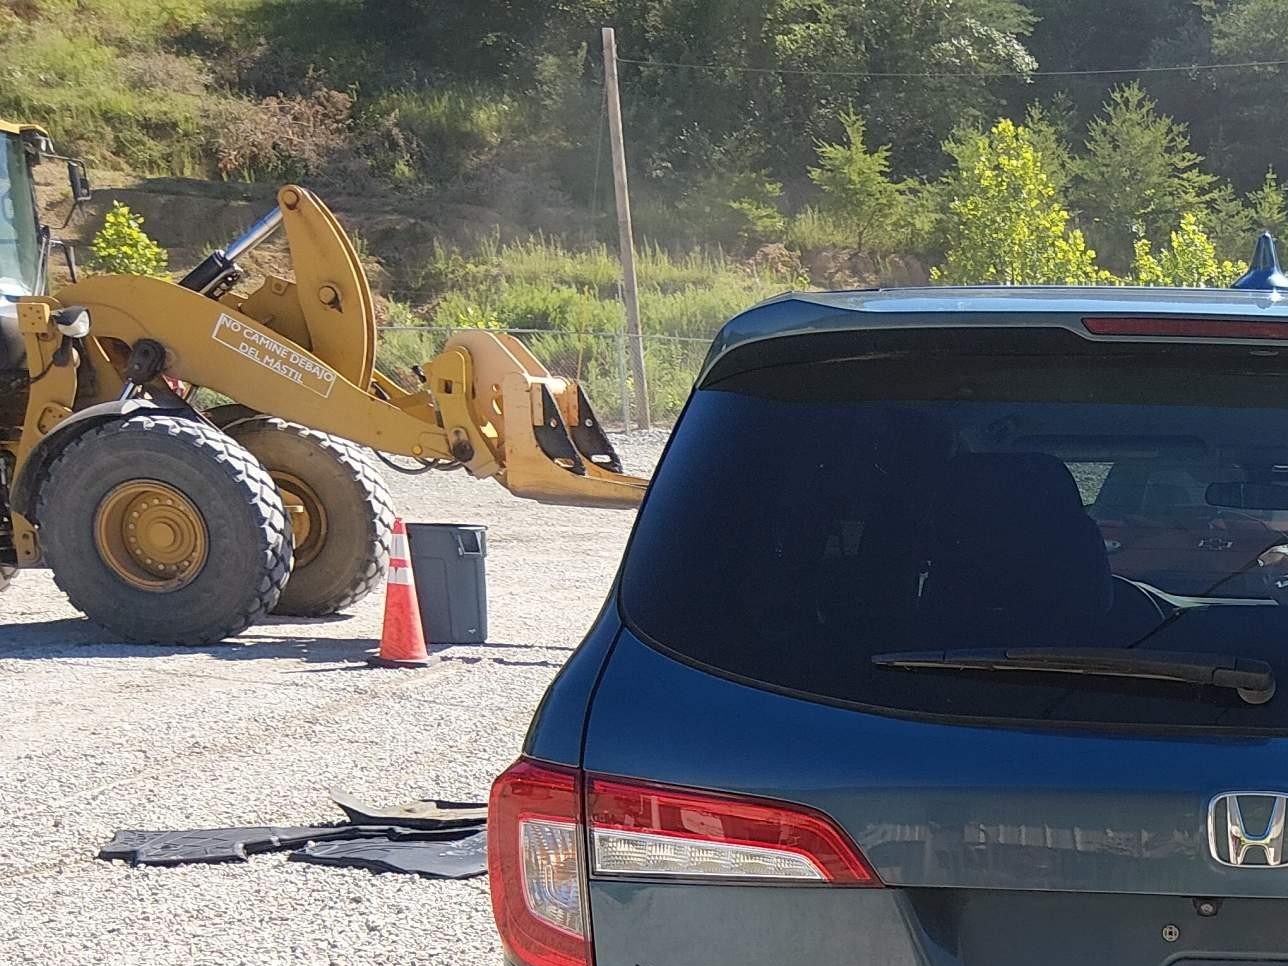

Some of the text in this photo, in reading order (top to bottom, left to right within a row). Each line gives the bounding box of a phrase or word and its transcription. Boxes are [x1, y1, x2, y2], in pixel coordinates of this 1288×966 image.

[221, 316, 334, 382] NO CAMINE DEBAJO
[239, 342, 304, 384] DEL MÁSTIL
